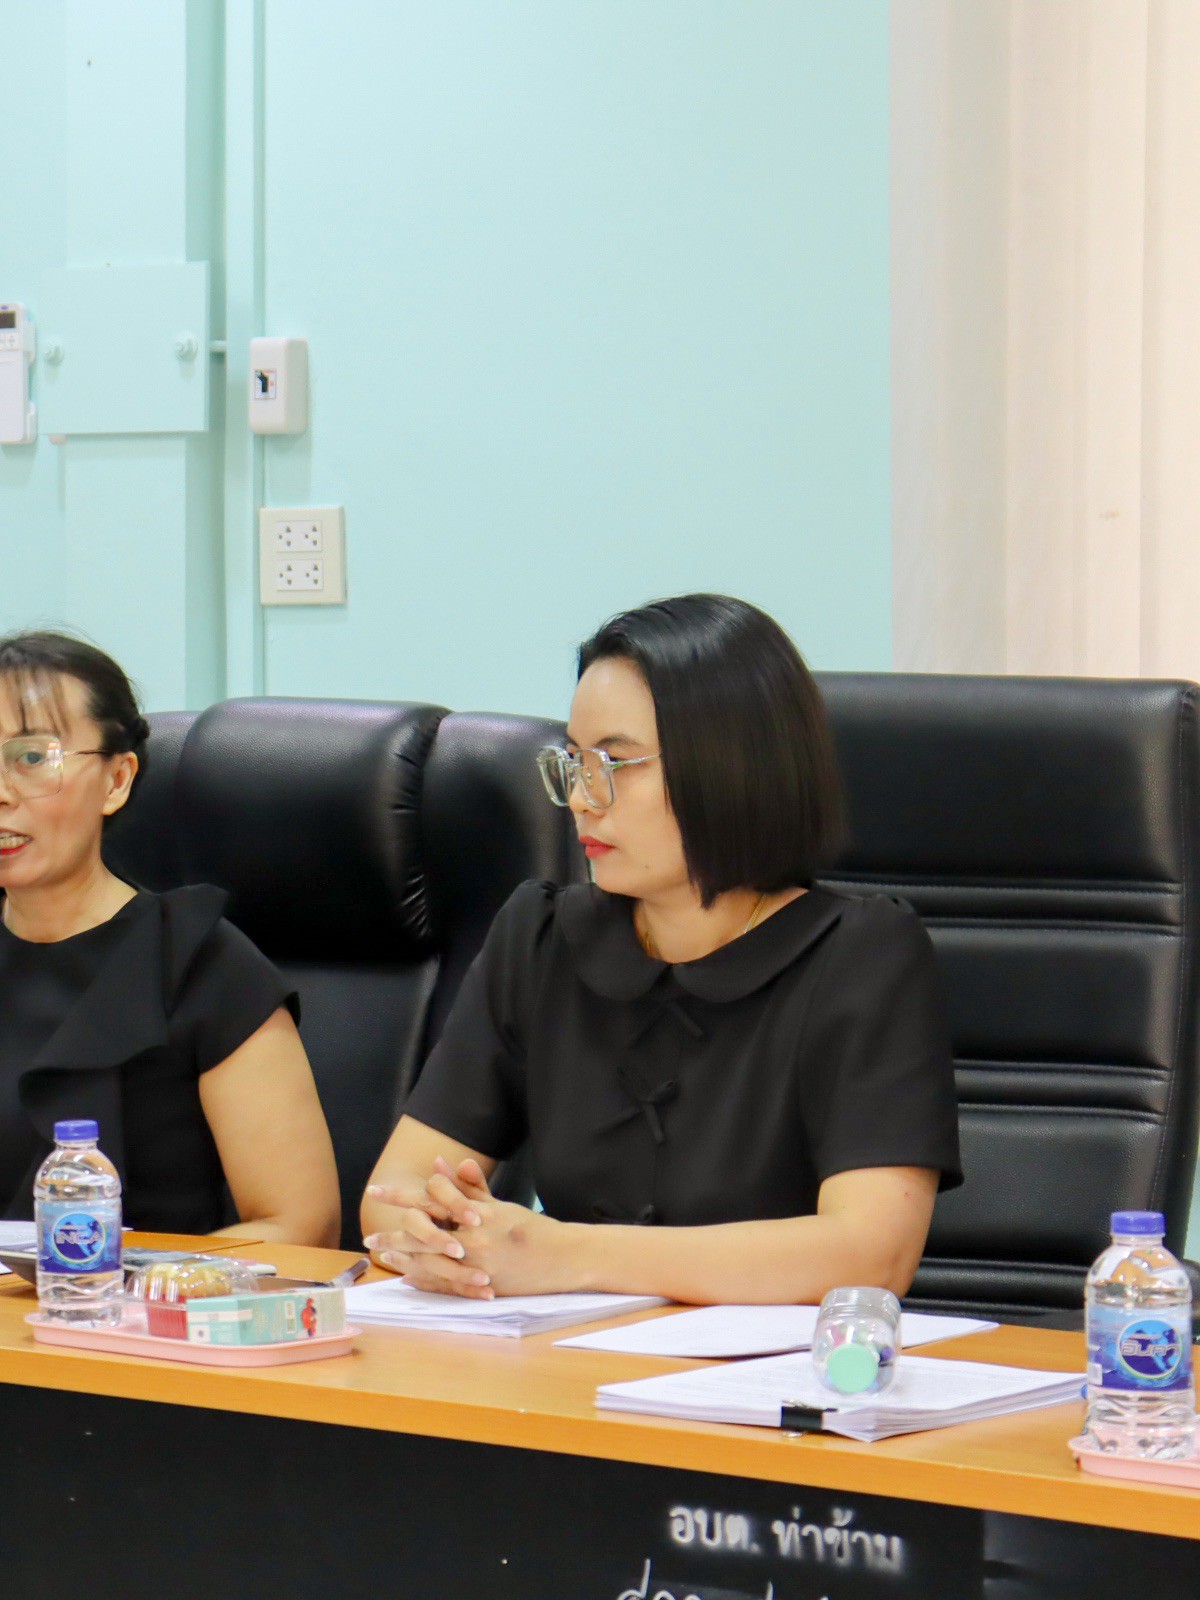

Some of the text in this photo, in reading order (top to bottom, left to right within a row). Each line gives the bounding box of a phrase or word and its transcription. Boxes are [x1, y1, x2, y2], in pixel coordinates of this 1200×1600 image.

[55, 1231, 103, 1245] INCA
[668, 1505, 904, 1573] อบต. ท่าข้าม
